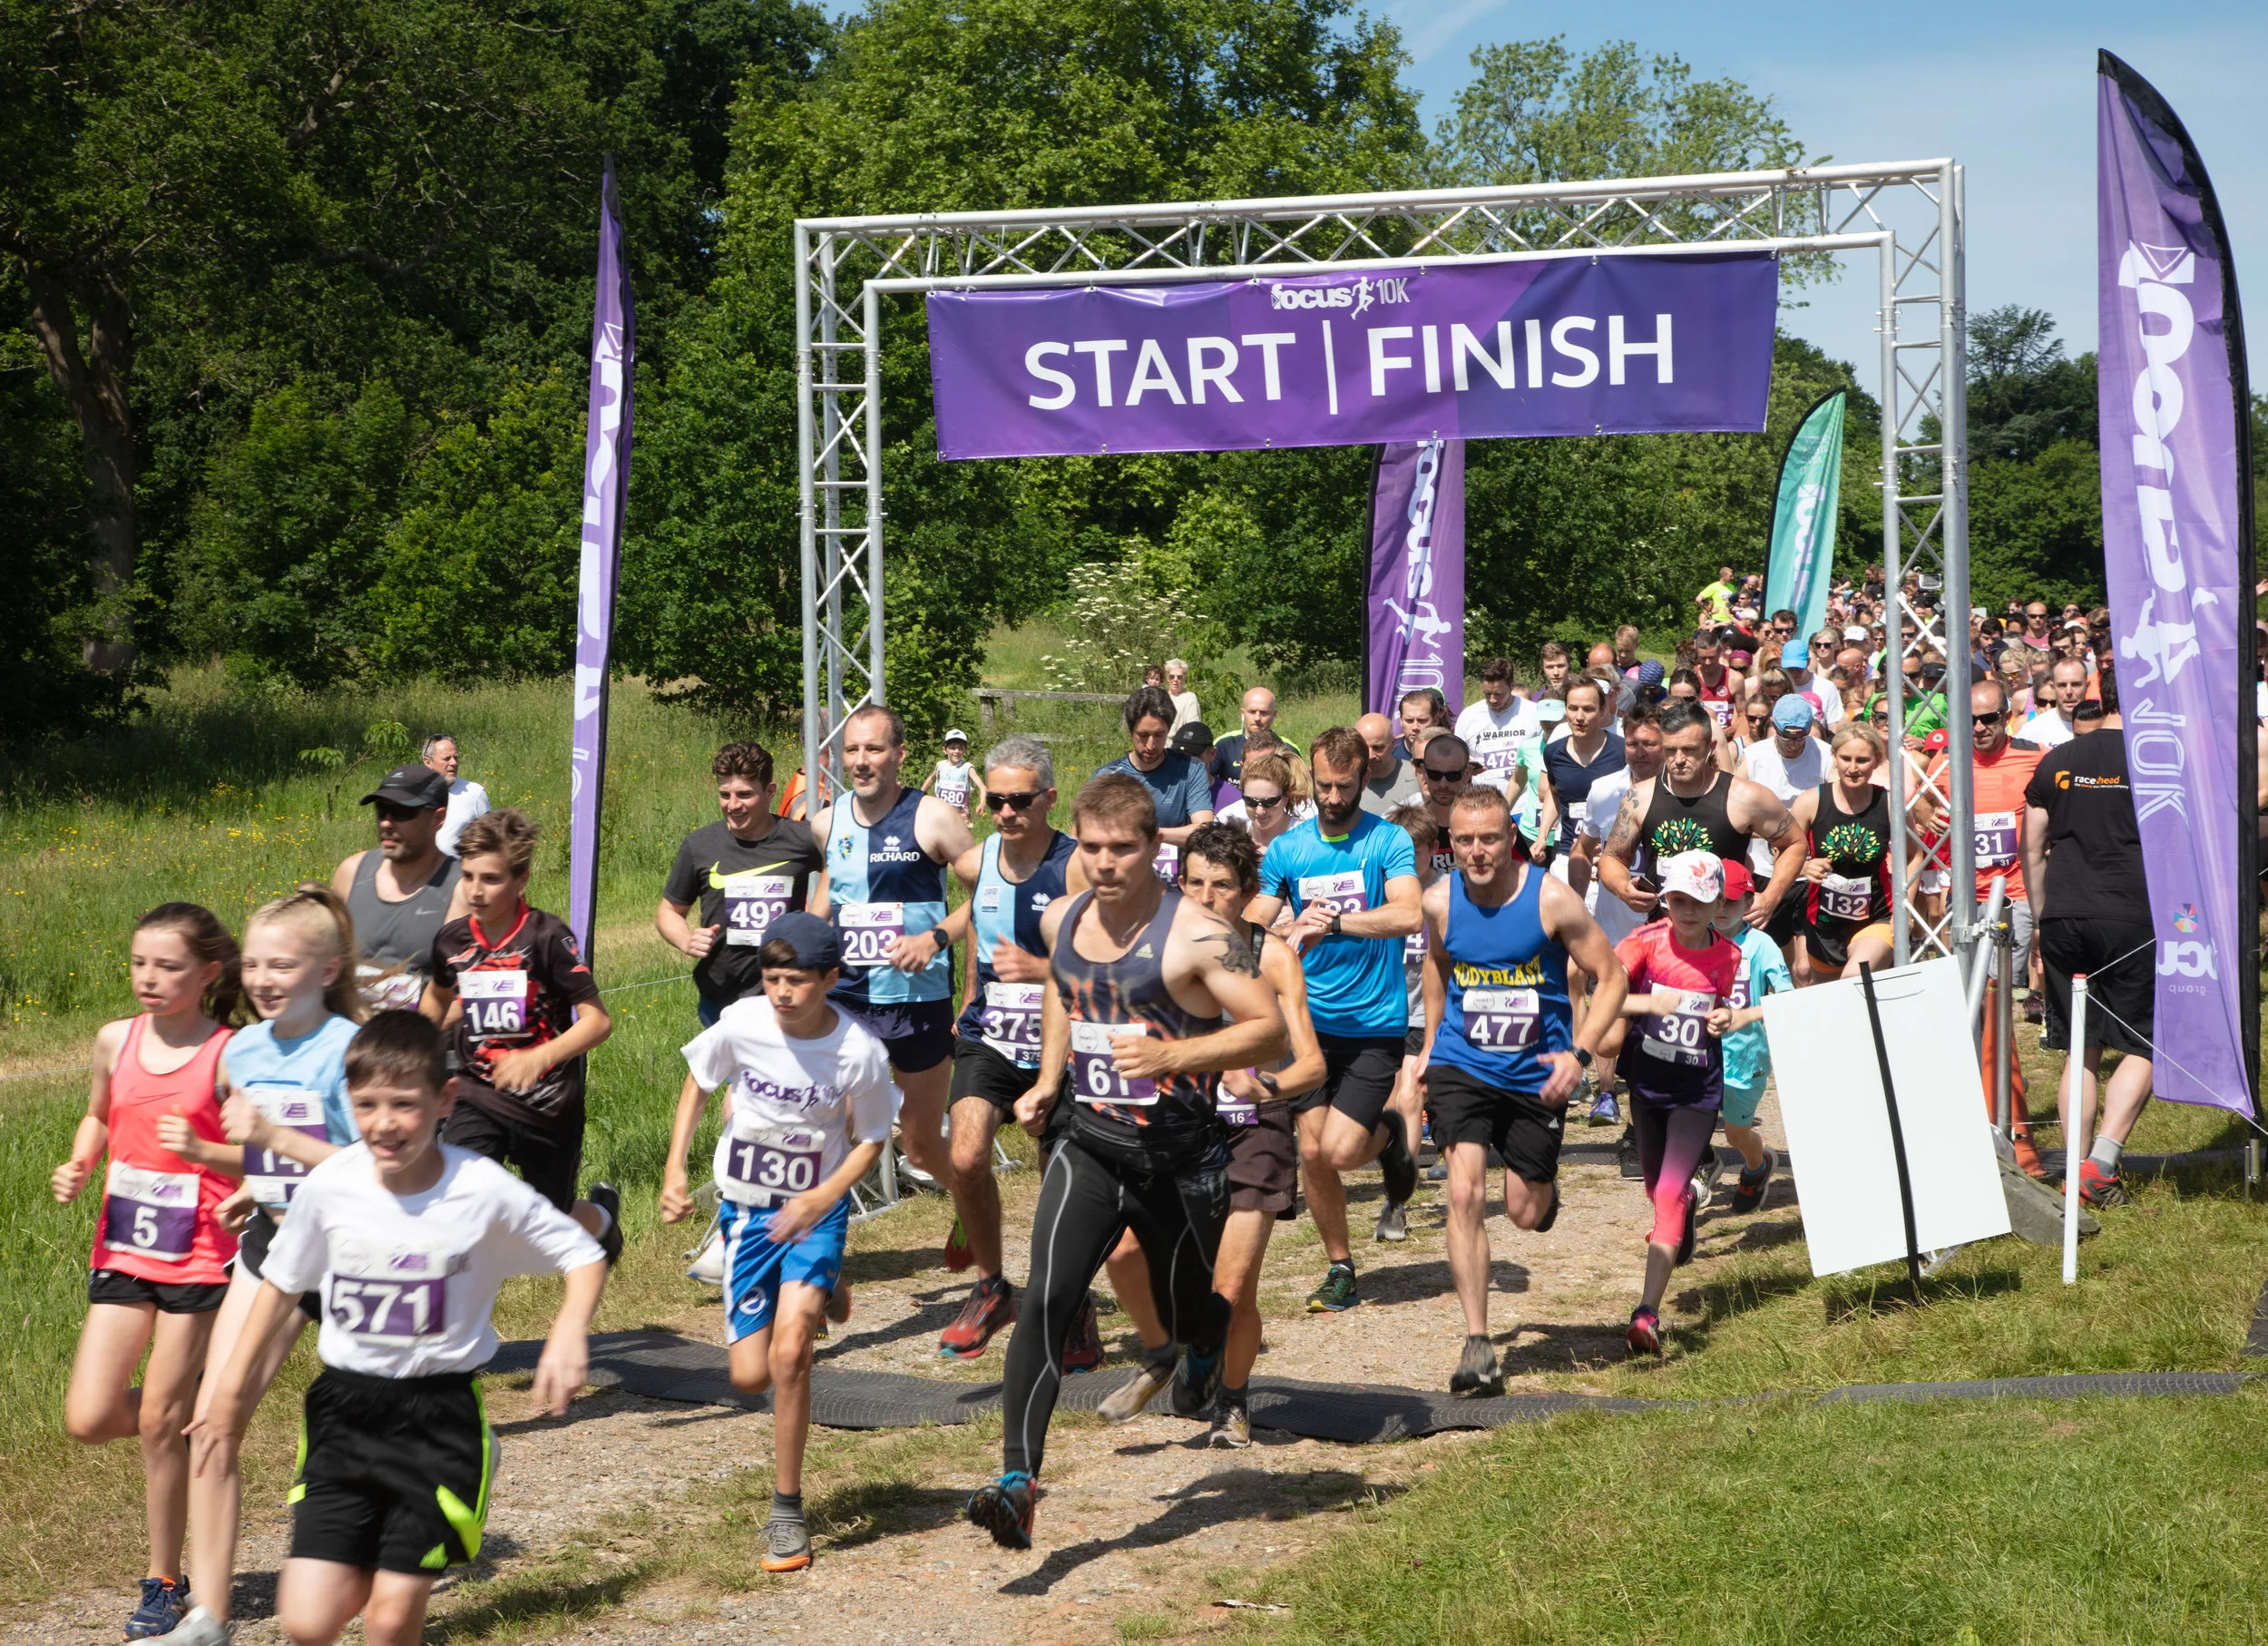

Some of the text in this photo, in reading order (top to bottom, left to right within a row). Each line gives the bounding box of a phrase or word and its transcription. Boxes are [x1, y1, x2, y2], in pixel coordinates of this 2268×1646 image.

[1271, 278, 1410, 309] focus 10K
[1024, 332, 1296, 410] START
[1367, 314, 1674, 397] FINISH
[1394, 652, 1444, 719] 10
[1716, 712, 1726, 725] 6
[1483, 730, 1526, 740] WARRIOR
[1486, 750, 1517, 769] 479
[940, 789, 964, 804] 580
[869, 851, 921, 863] RICHARD
[1974, 832, 2002, 855] 31
[1433, 853, 1456, 868] RU
[729, 901, 787, 928] 492
[1825, 892, 1867, 916] 132
[843, 929, 897, 958] 203
[1728, 984, 1745, 1009] 5
[466, 1002, 521, 1034] 146
[983, 1010, 1042, 1043] 375
[1470, 1014, 1533, 1044] 477
[1658, 1014, 1700, 1047] 30
[1022, 1051, 1041, 1062] 375
[1685, 1055, 1698, 1065] 30
[1088, 1058, 1129, 1095] 61
[1229, 1112, 1245, 1123] 16
[736, 1145, 814, 1191] 130
[132, 1205, 158, 1248] 5
[331, 1279, 430, 1334] 571
